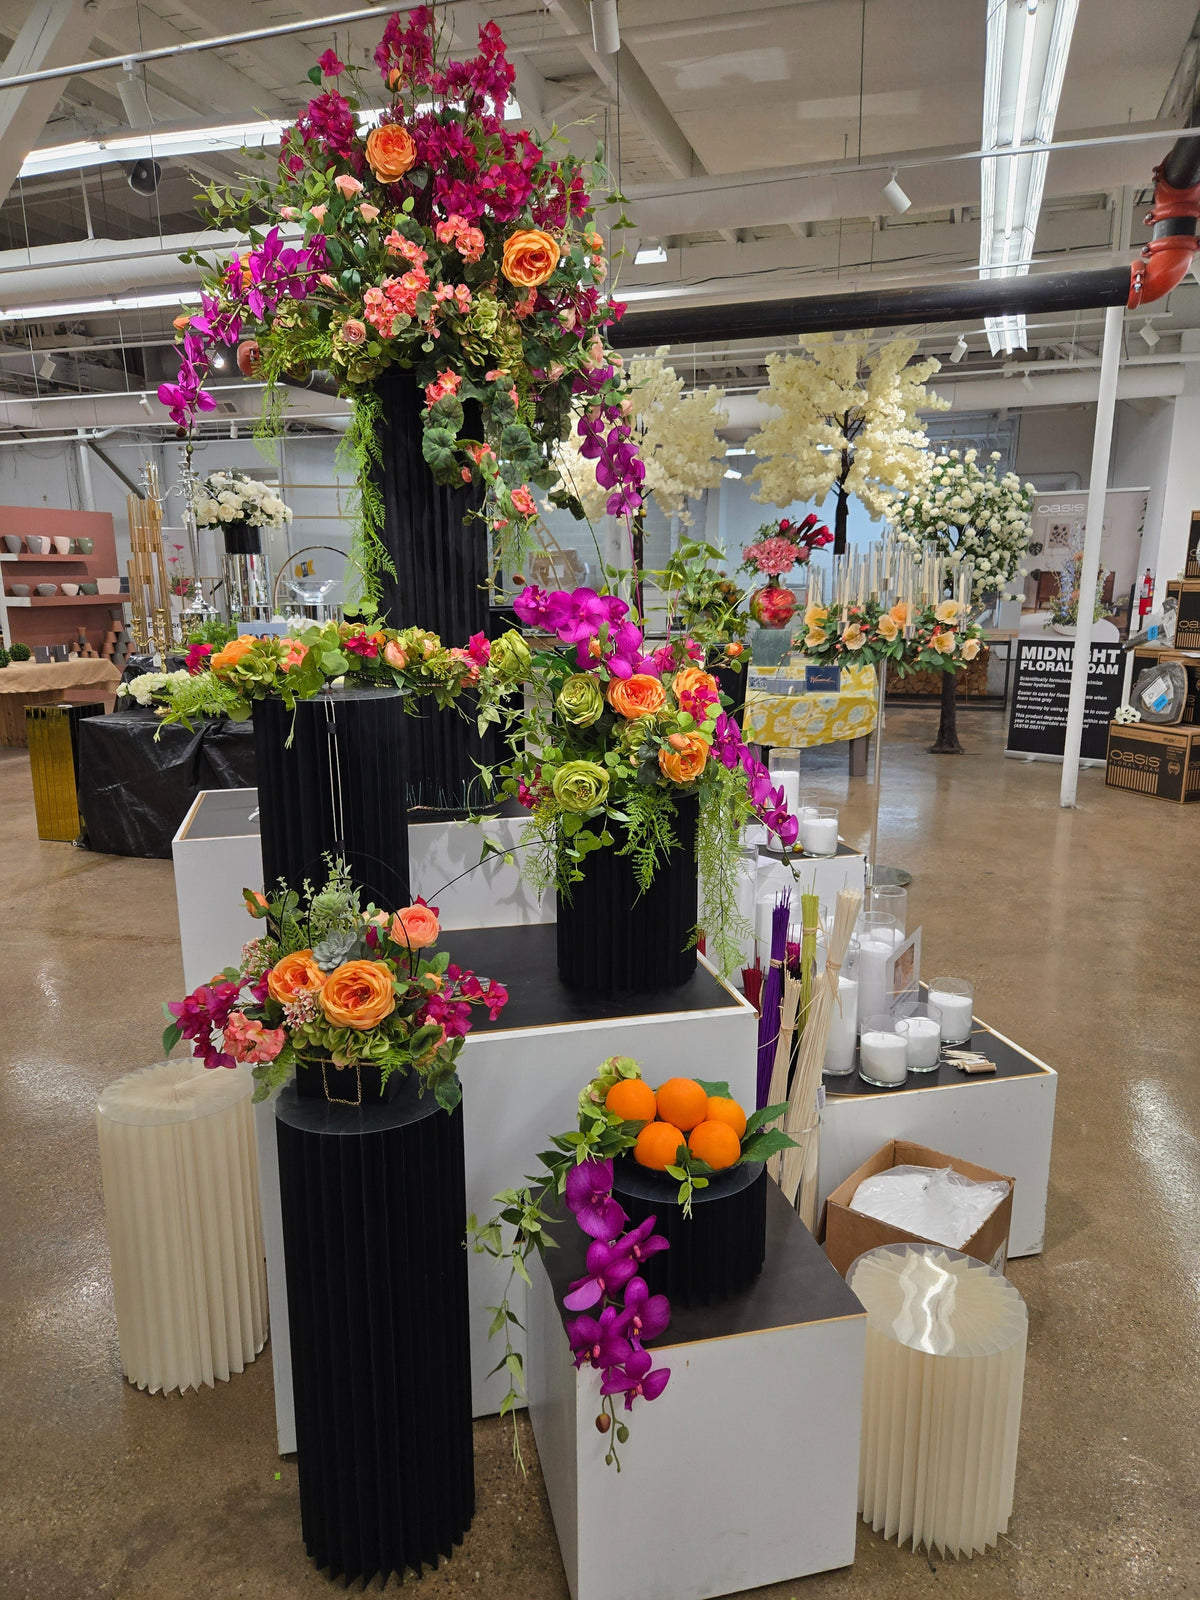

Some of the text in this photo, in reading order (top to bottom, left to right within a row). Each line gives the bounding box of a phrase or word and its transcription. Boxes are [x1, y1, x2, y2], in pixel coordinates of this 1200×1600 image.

[1021, 646, 1121, 663] MIDNHT
[1020, 660, 1119, 675] FLORAL OAM
